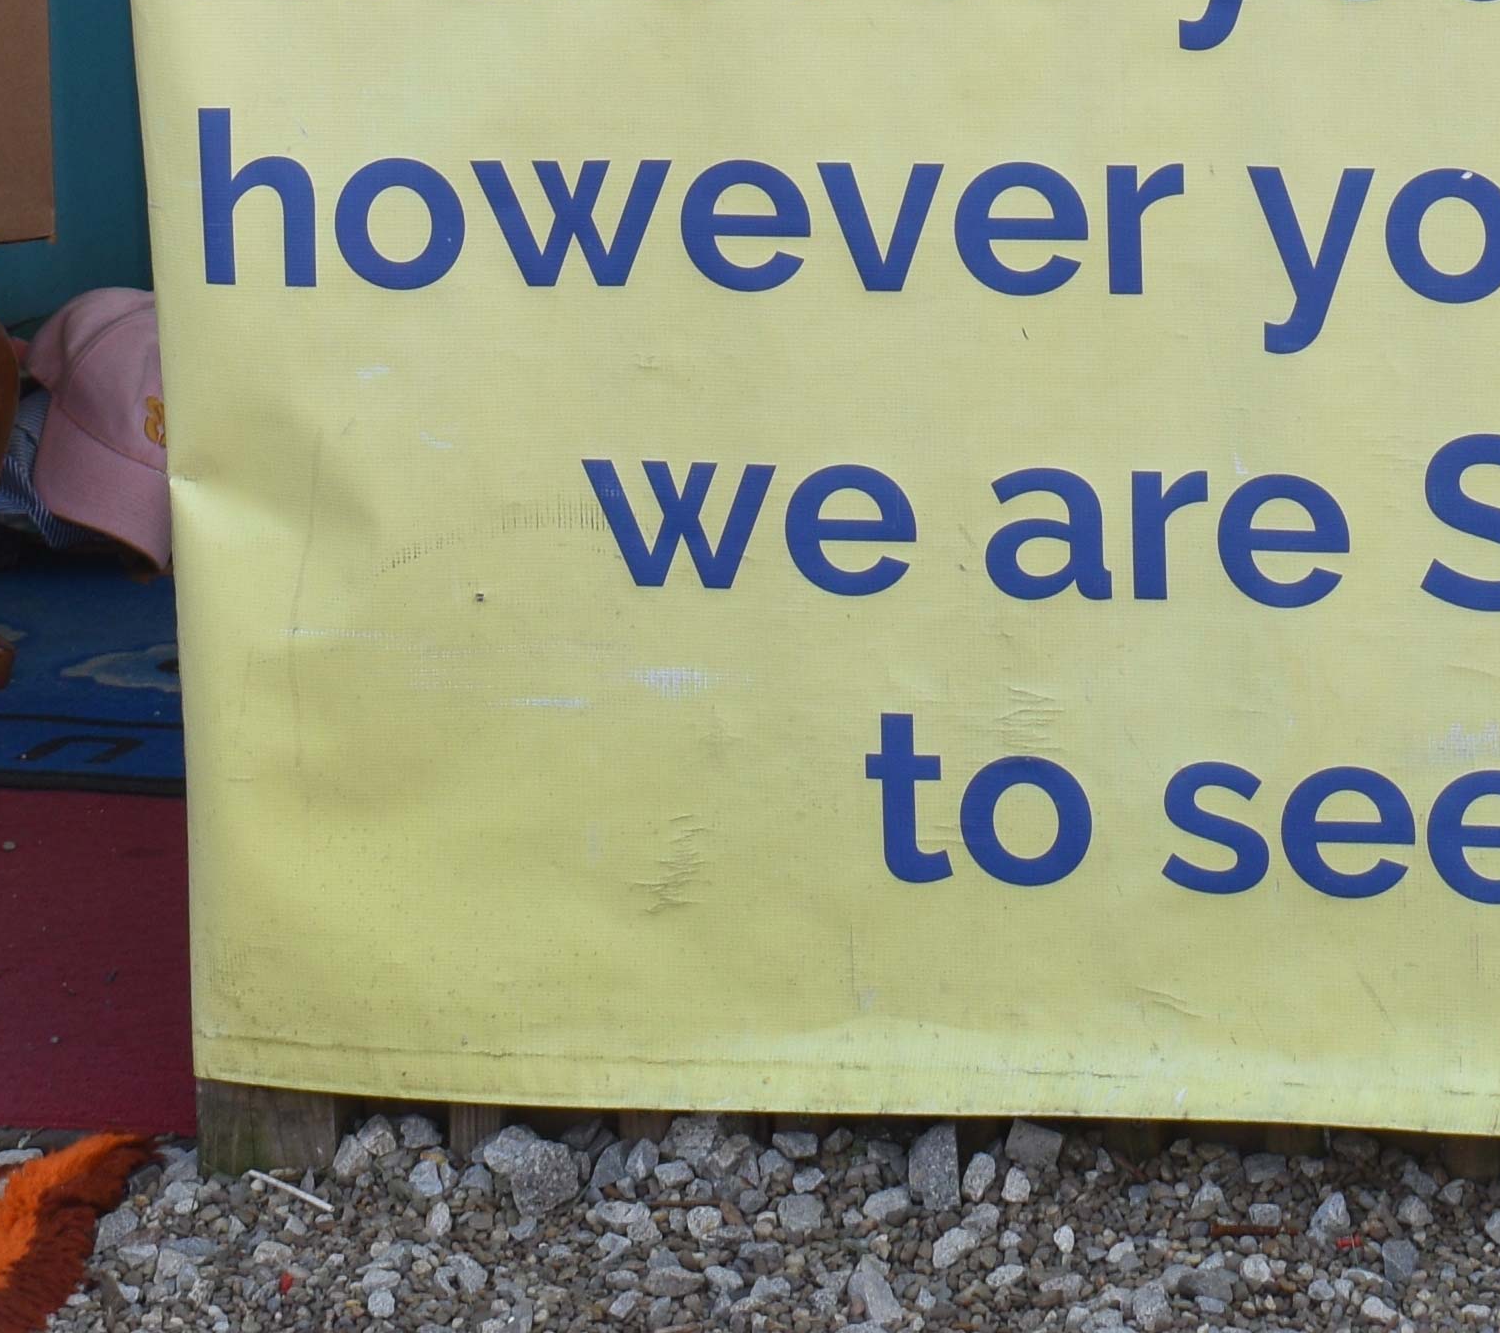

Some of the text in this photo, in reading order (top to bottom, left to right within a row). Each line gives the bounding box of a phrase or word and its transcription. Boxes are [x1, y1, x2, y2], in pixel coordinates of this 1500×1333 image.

[195, 106, 1183, 297] however
[580, 450, 920, 596] we
[985, 466, 1352, 610] are
[863, 711, 1095, 889] to
